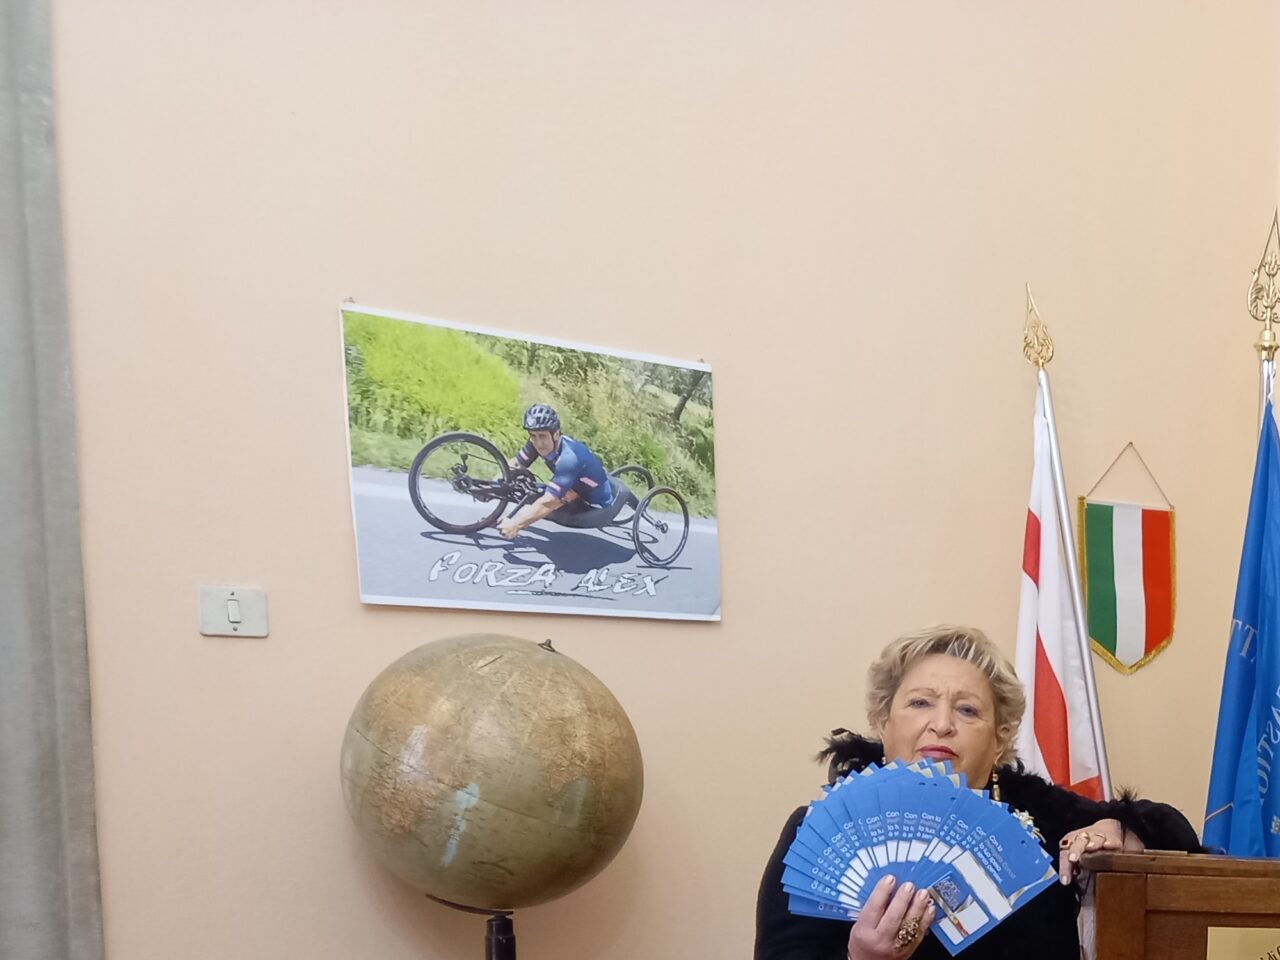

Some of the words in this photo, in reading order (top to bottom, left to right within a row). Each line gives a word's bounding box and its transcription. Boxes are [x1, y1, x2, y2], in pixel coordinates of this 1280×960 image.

[429, 551, 556, 588] FORZA
[571, 568, 669, 596] ALEX
[989, 835, 999, 846] Con
